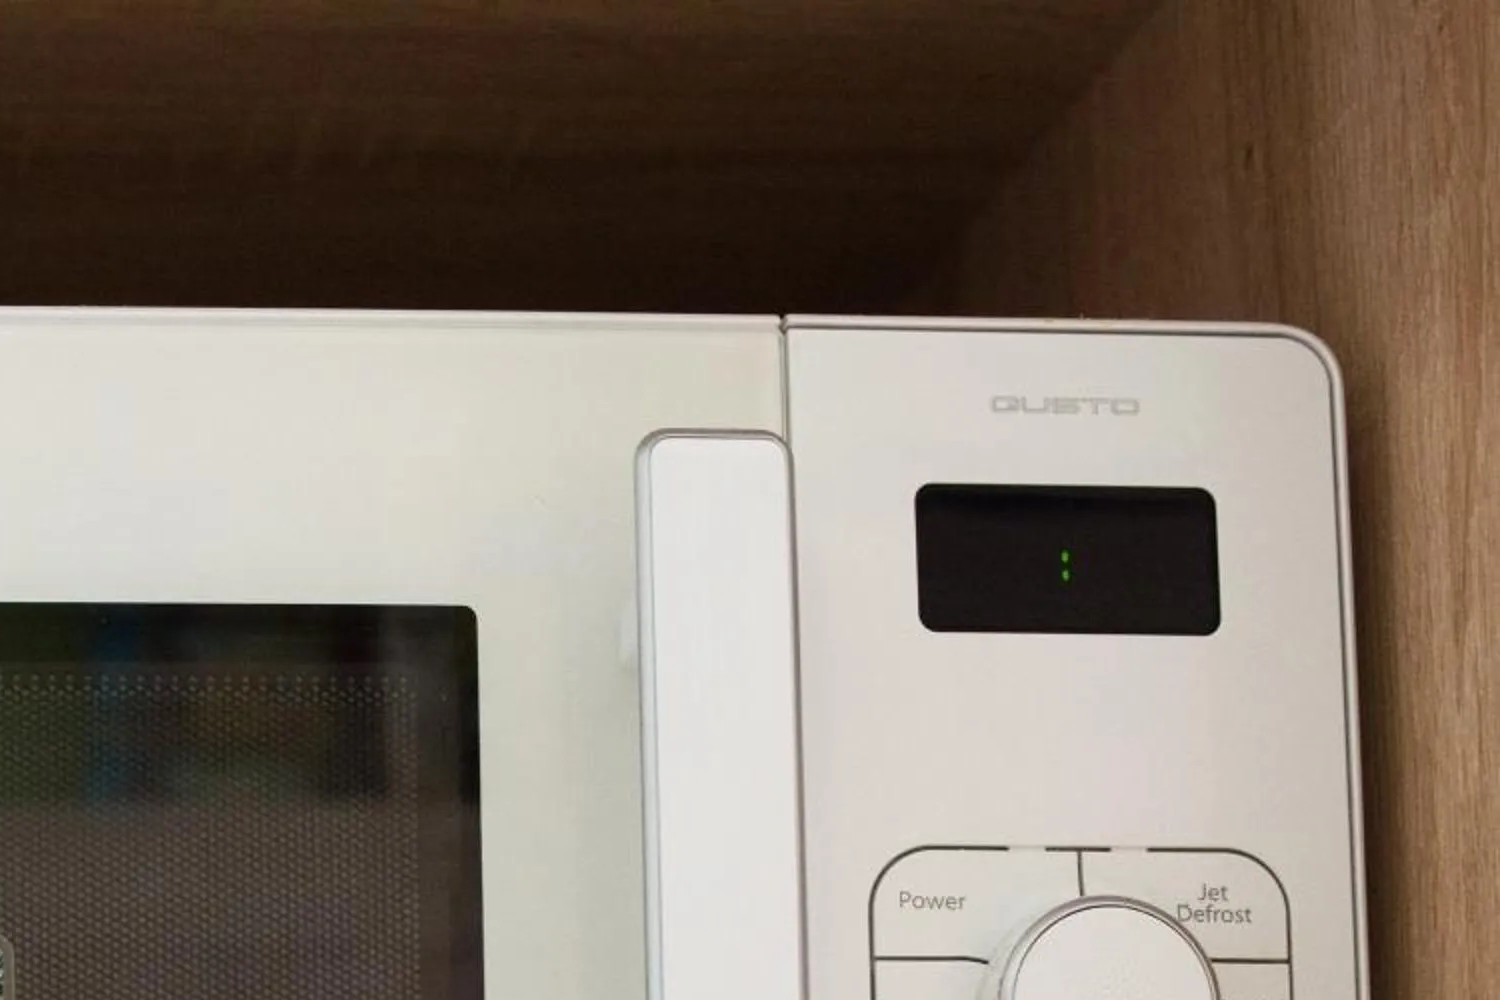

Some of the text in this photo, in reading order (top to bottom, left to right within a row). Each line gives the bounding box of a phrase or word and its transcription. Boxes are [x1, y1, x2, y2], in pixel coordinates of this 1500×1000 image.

[898, 890, 966, 911] Power
[1197, 883, 1229, 901] Jet
[1177, 903, 1252, 923] Defrost
